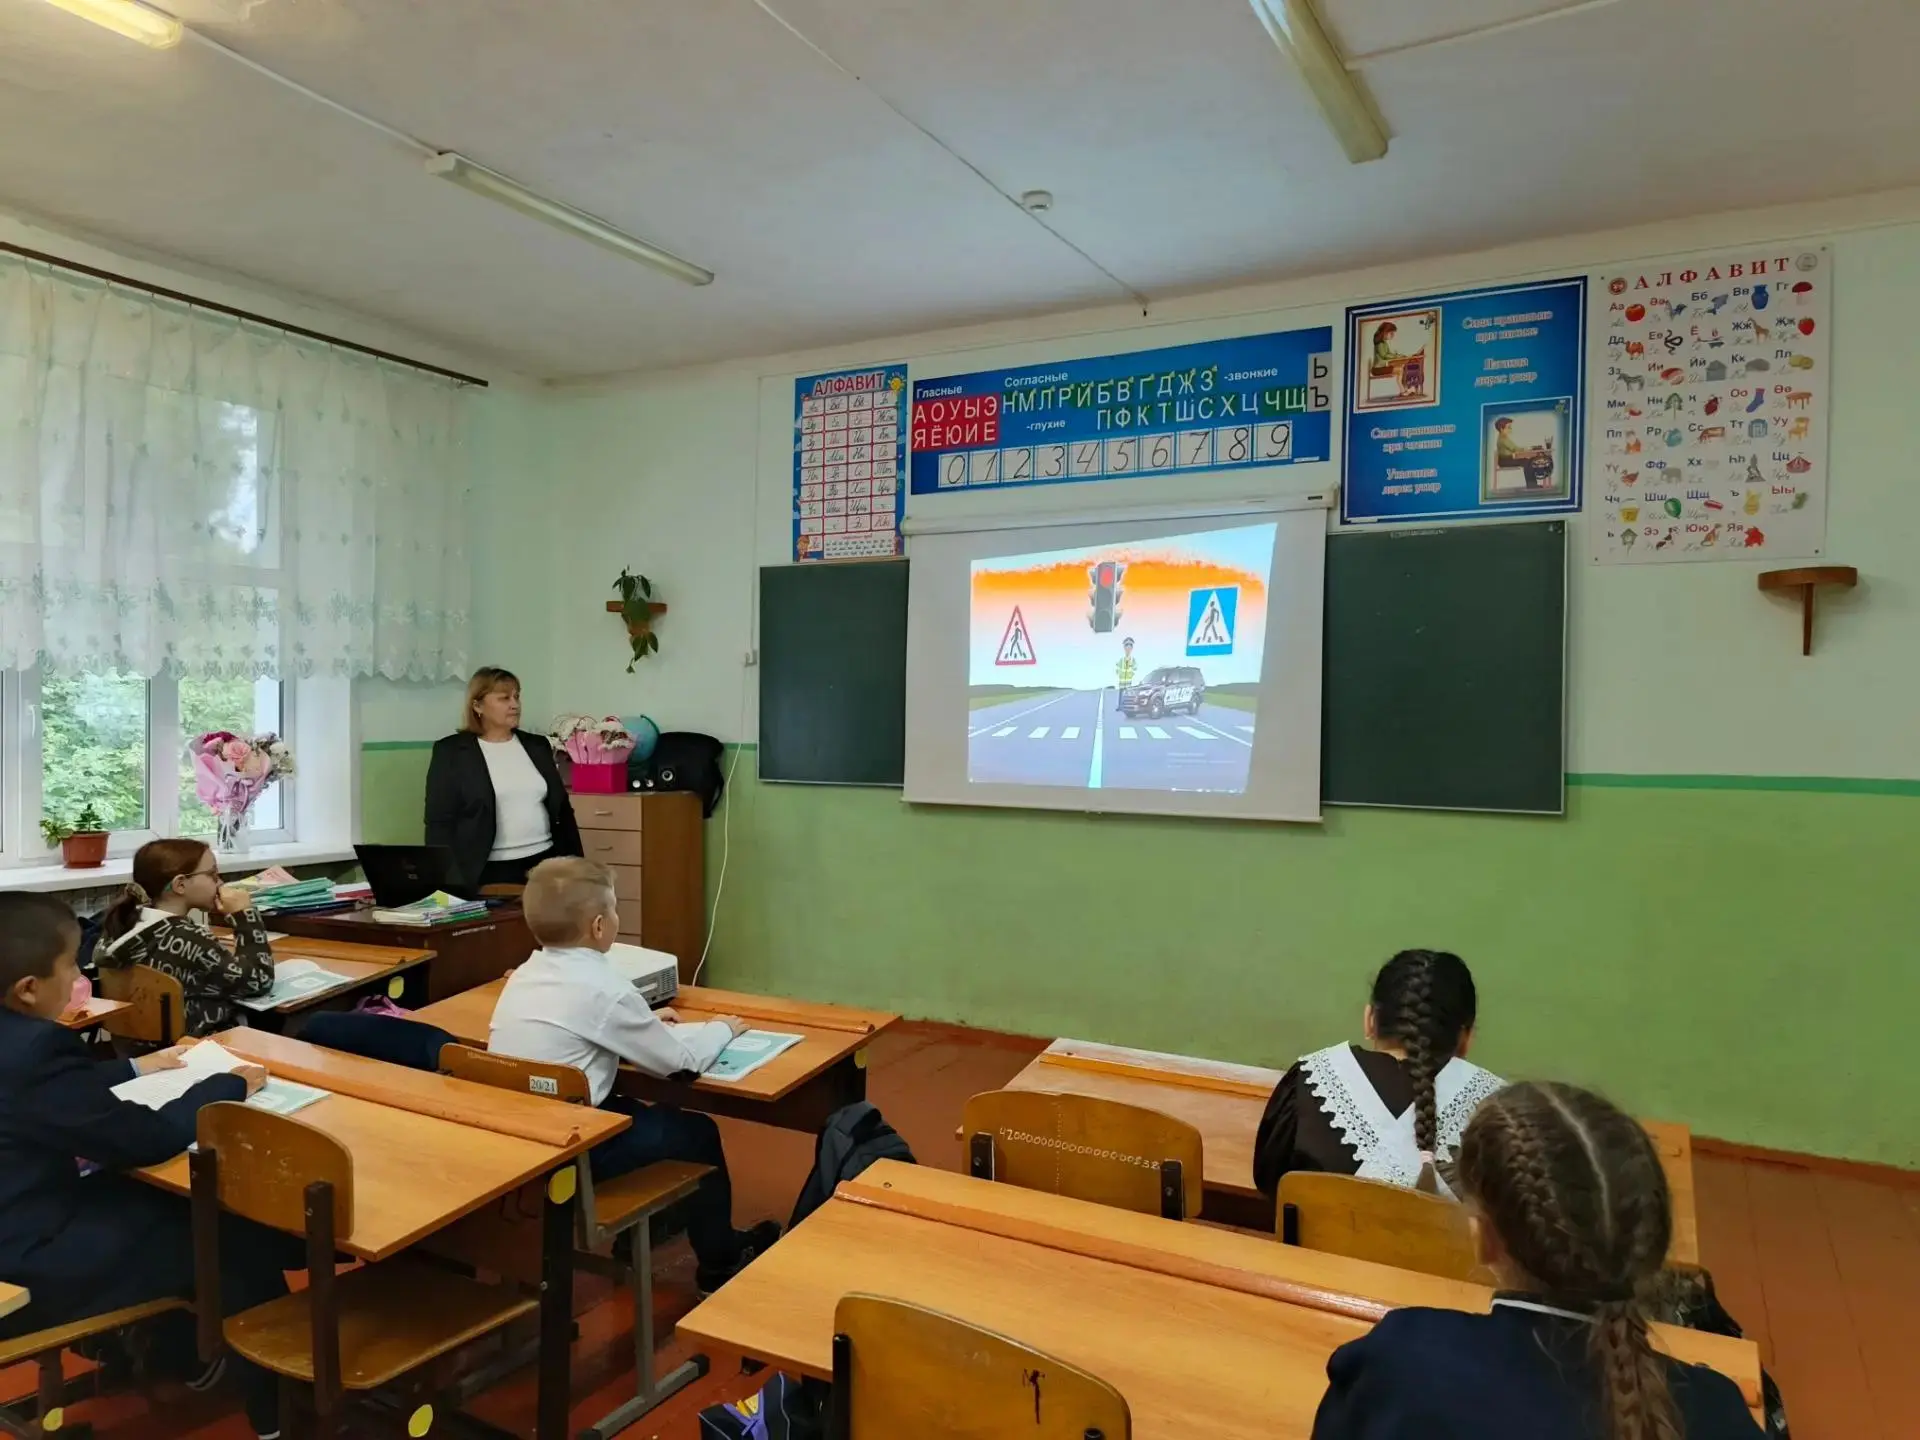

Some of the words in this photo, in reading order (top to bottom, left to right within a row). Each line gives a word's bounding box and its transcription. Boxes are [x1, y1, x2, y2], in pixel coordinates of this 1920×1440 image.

[1634, 257, 1790, 290] АЛФАВИТ
[1691, 292, 1708, 301] Бб
[1733, 287, 1750, 296] Вв
[1004, 371, 1069, 388] Согласные
[1224, 366, 1279, 382] -звонкие
[814, 373, 885, 396] АЛФАВИТ
[916, 385, 963, 399] Гласные
[1026, 419, 1066, 431] -глухие
[984, 451, 998, 481] 1
[1014, 448, 1031, 479] 2
[1045, 445, 1065, 477] 3
[1076, 441, 1101, 473] 4
[1113, 439, 1136, 471] 5
[1151, 435, 1172, 468] 6
[1190, 431, 1210, 465] 7
[1228, 427, 1249, 461] 8
[1266, 423, 1290, 458] 9
[530, 1078, 555, 1093] 20/21
